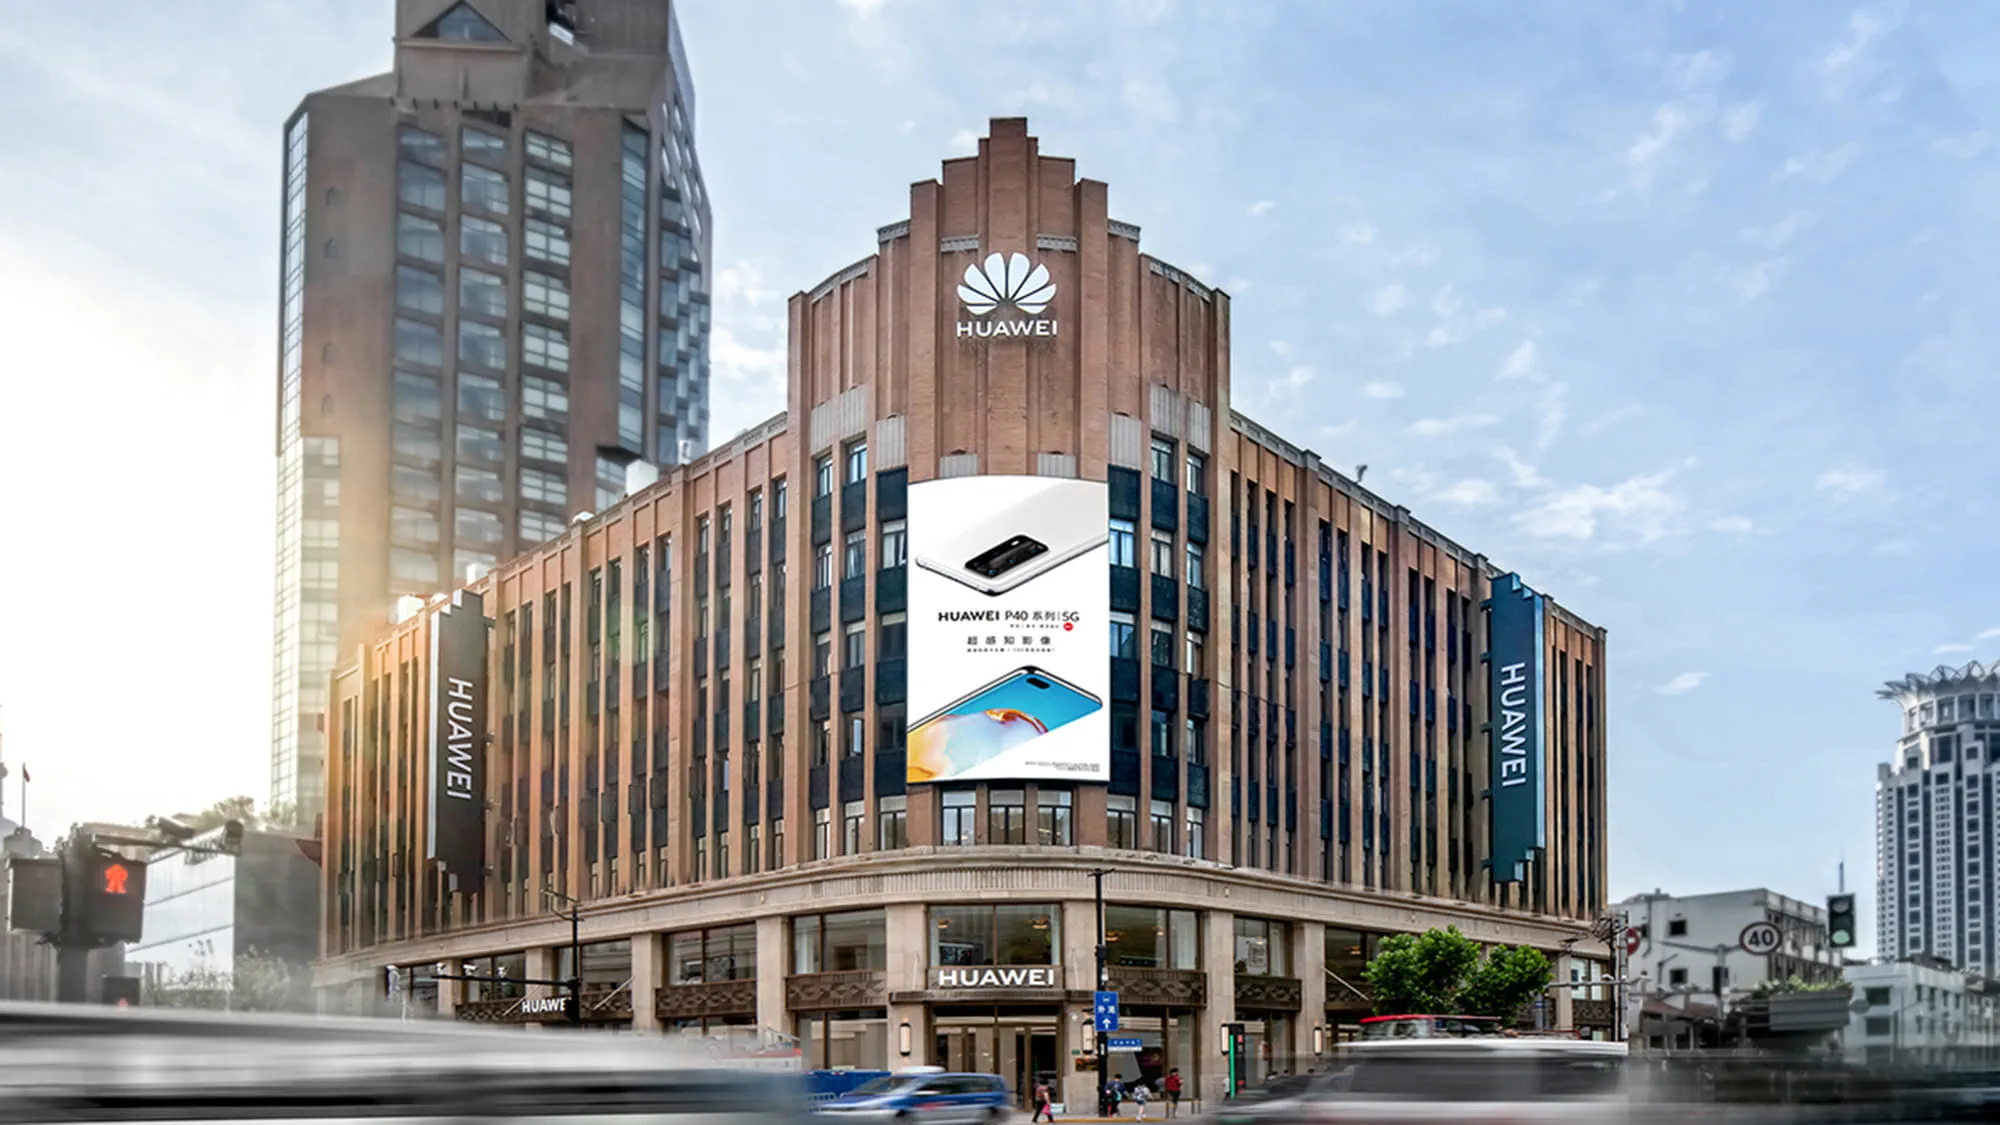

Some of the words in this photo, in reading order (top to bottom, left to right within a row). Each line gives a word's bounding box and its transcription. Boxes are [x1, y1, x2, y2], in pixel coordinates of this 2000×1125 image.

[956, 320, 1058, 337] HUAWEI
[938, 611, 1000, 622] HUAWEI
[1005, 610, 1029, 621] P40
[1501, 662, 1527, 787] HUAWEI
[447, 677, 473, 799] HUAWEI
[1748, 929, 1775, 947] 40
[938, 969, 1055, 986] HUAWEI
[521, 997, 571, 1013] HUAWE
